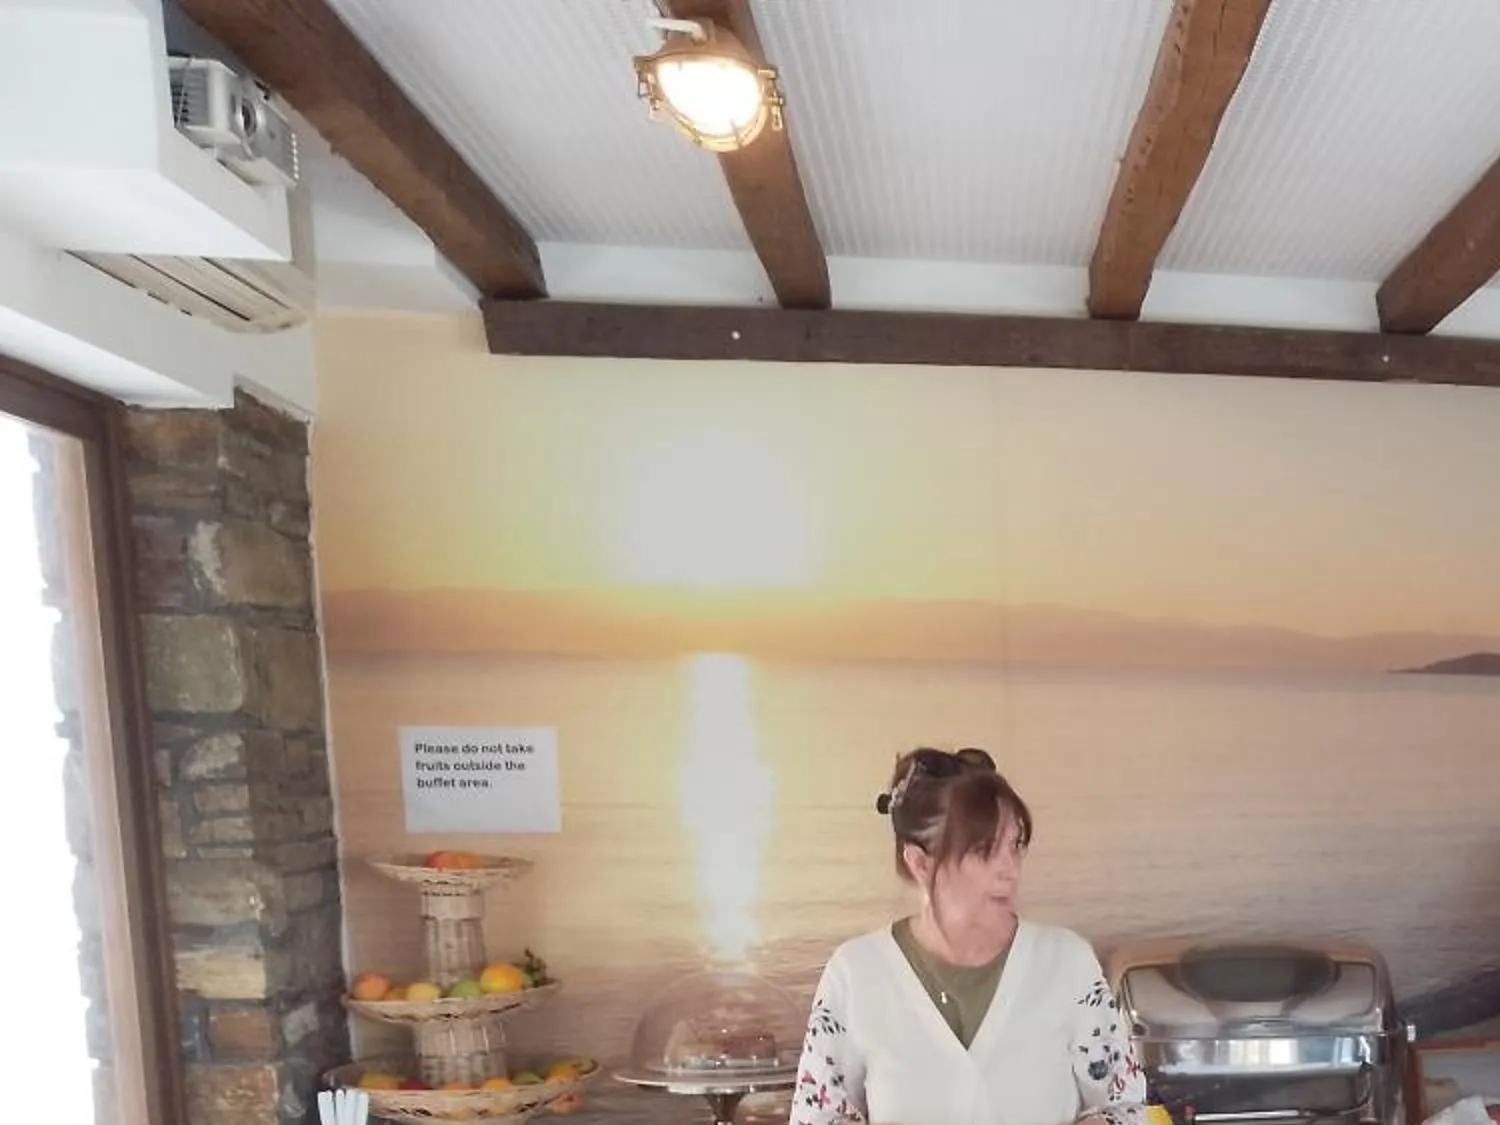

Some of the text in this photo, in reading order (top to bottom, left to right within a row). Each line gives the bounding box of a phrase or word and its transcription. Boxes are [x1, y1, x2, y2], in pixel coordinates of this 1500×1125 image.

[415, 743, 535, 755] Please do not take
[415, 760, 527, 772] fruits outside the
[417, 777, 457, 789] buffet
